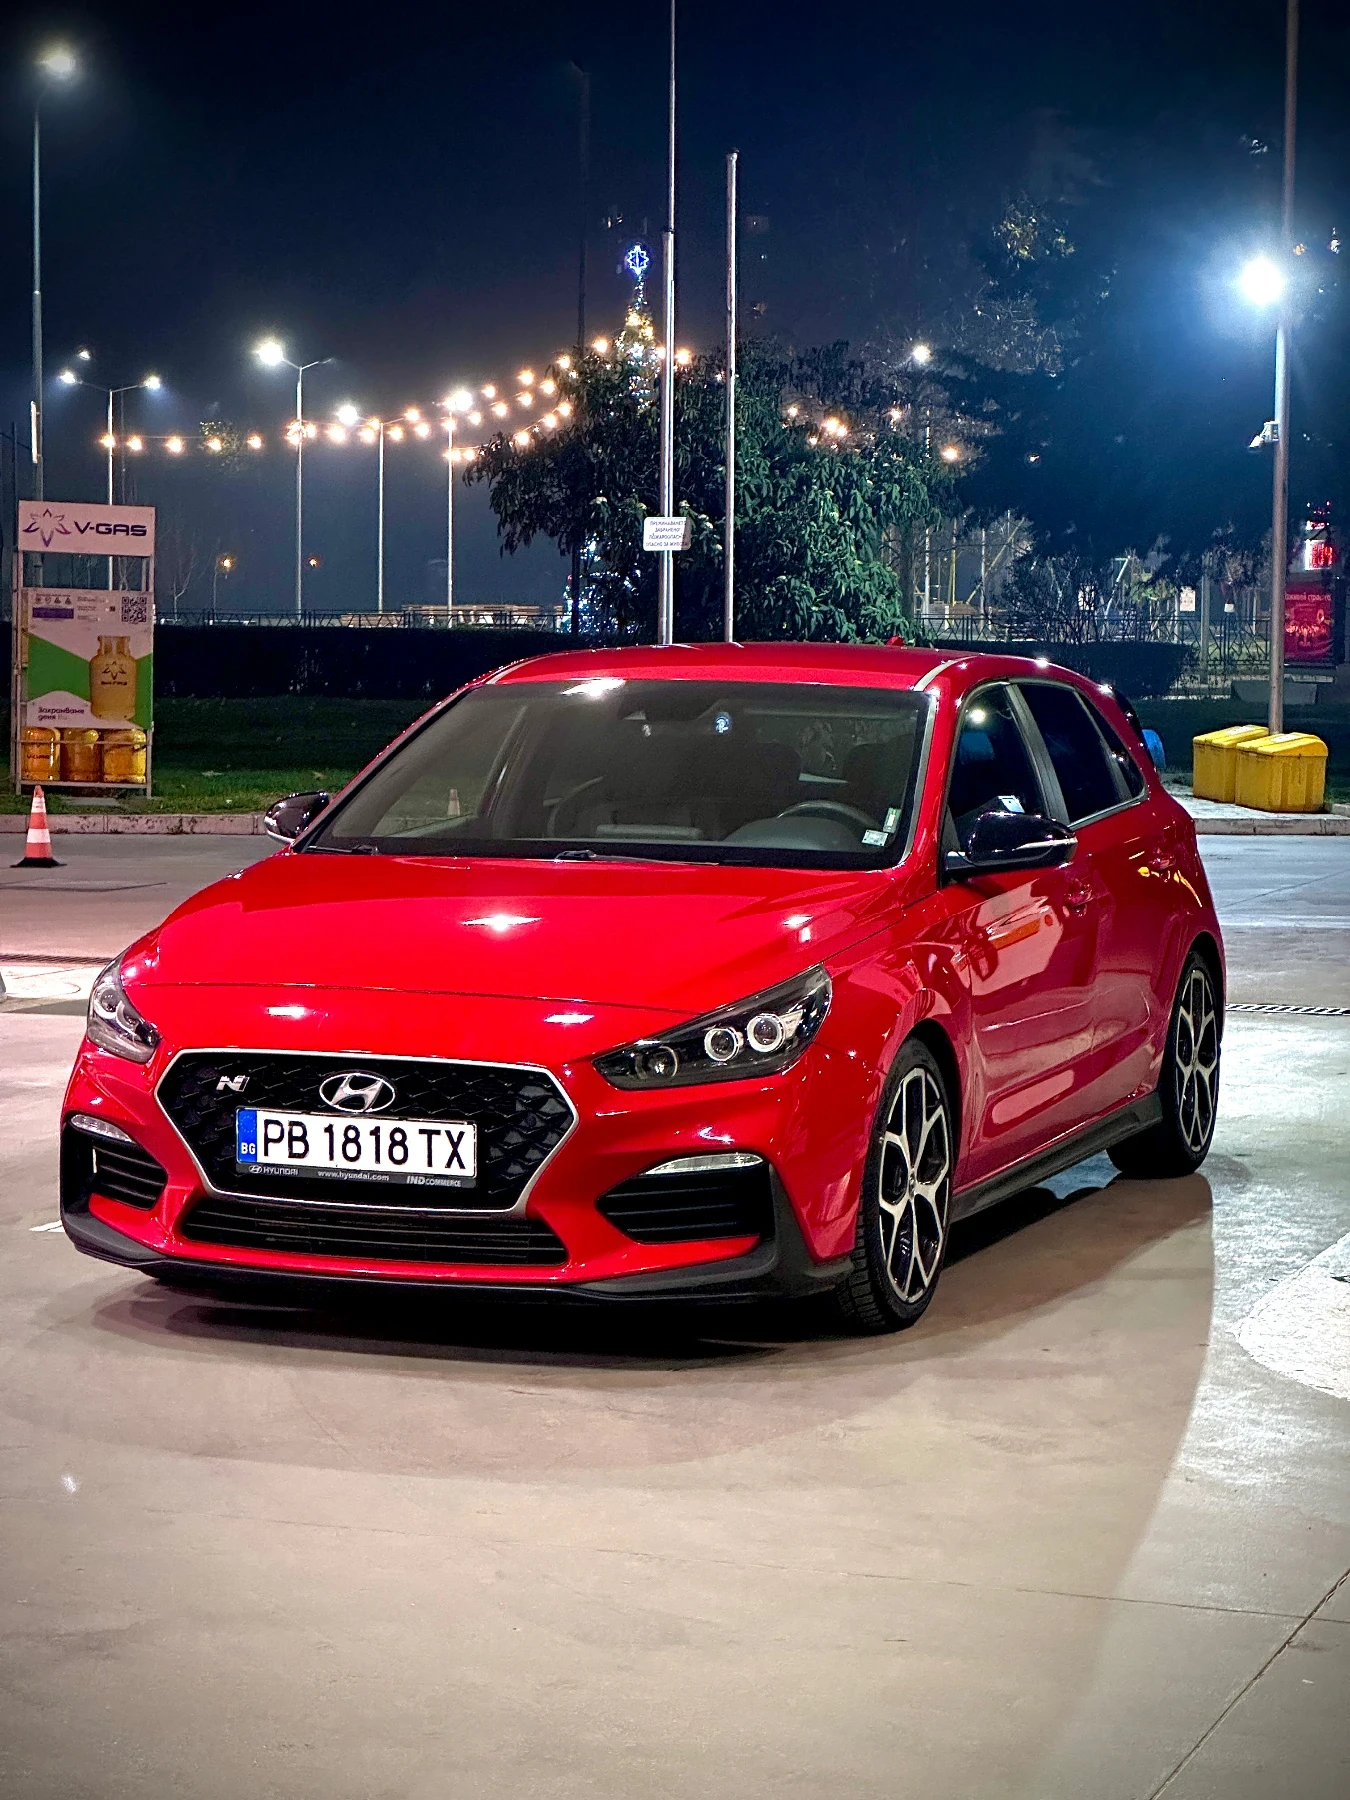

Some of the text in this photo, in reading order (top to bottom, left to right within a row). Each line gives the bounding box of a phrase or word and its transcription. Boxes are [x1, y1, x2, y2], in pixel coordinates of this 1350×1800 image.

[74, 521, 147, 536] V-GAS
[241, 1142, 256, 1155] BG
[263, 1119, 466, 1169] PB 1818 TX
[263, 1166, 299, 1176] HYUNDAI
[317, 1170, 390, 1181] www.hyundai.com
